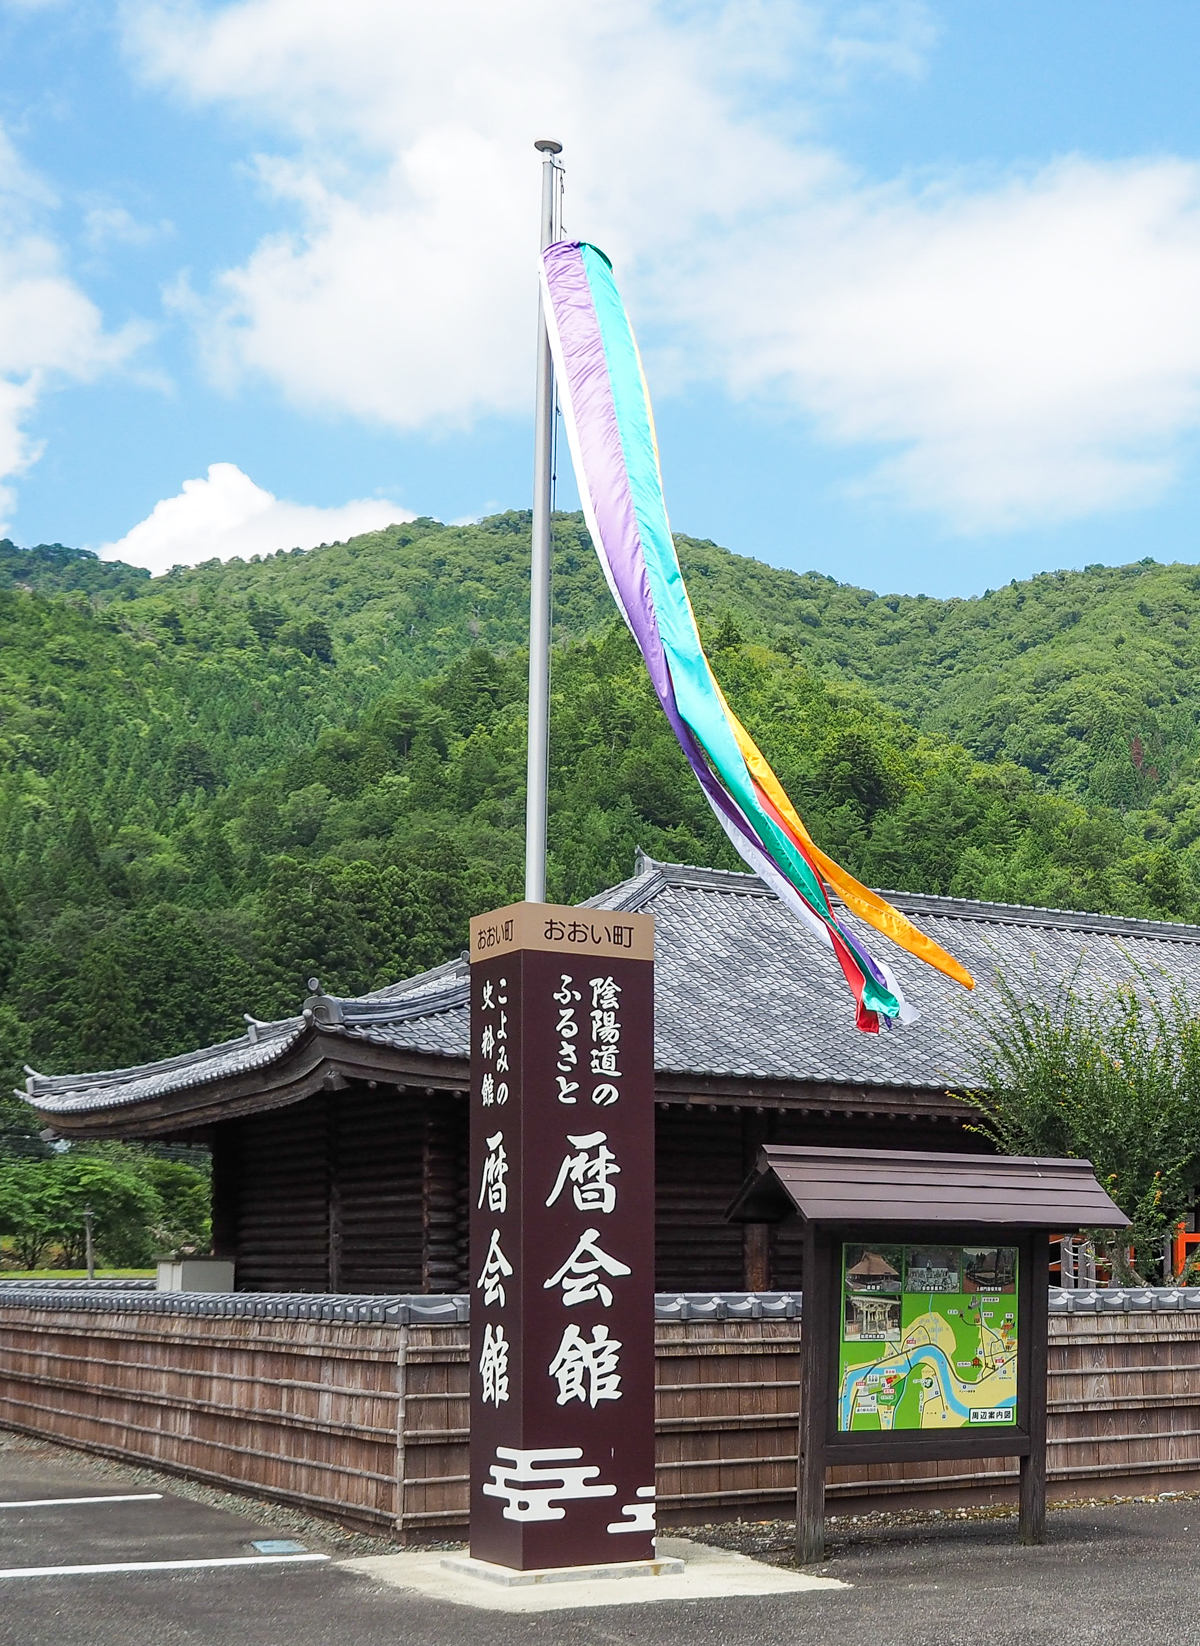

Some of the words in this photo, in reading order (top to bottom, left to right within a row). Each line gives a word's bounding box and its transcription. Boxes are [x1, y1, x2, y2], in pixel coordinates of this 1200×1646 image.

[477, 919, 514, 950] おおい町
[544, 918, 634, 949] おおい町
[481, 979, 496, 1107] 史料館
[496, 977, 509, 1106] こよみの
[553, 974, 582, 1104] ふるさと
[588, 975, 623, 1107] 陰陽道の
[477, 1130, 514, 1409] 暦会館
[543, 1130, 632, 1409] 暦会館
[971, 1410, 1012, 1420] 周辺案内図
